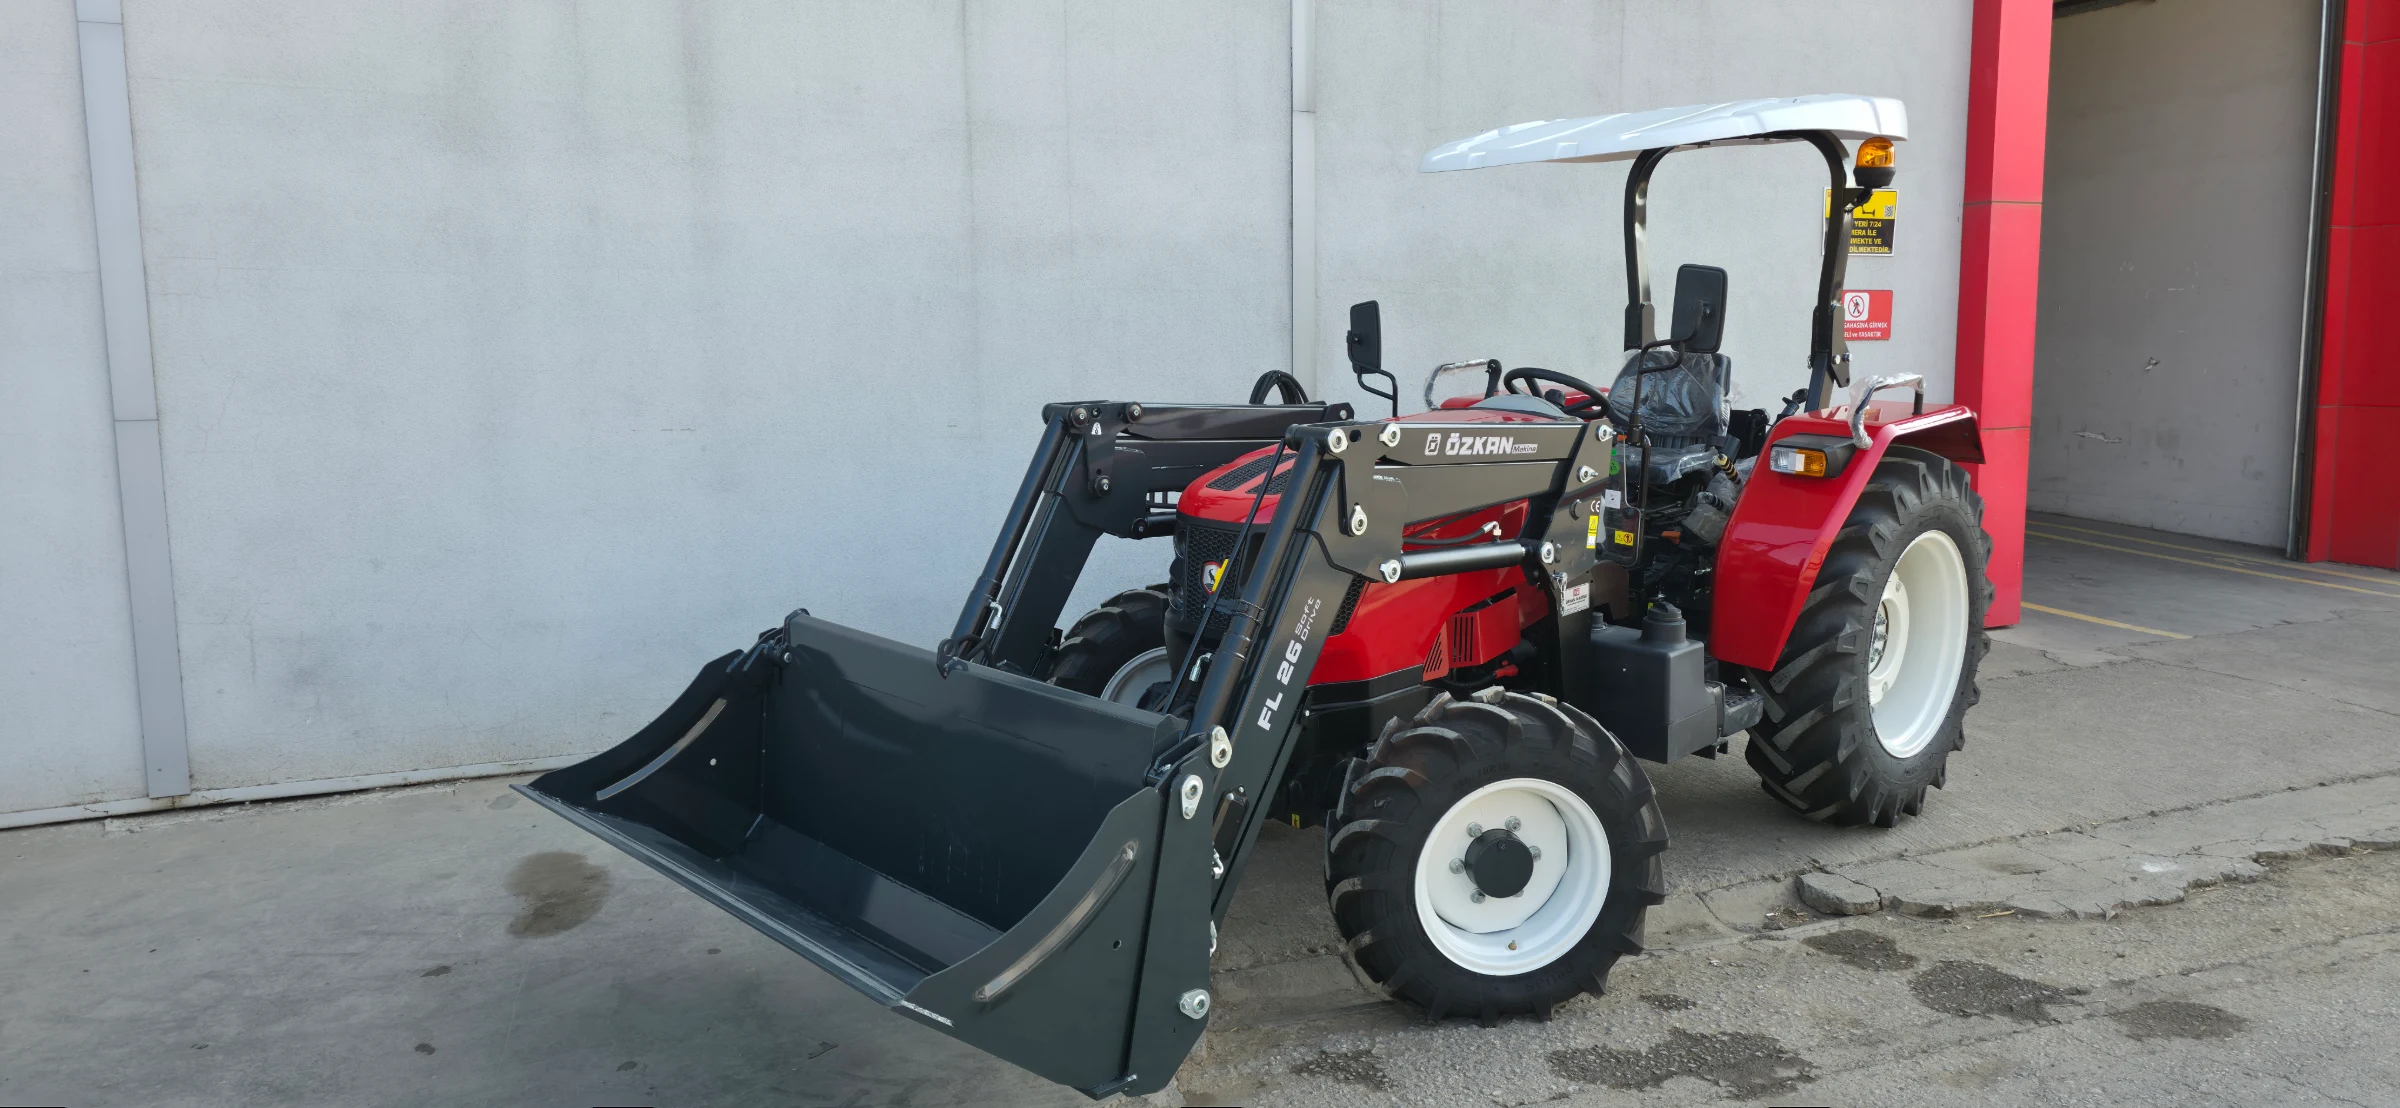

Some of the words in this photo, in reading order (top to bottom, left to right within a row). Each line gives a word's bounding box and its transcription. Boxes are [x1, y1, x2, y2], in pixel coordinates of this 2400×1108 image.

[1867, 228, 1877, 236] İLE
[1445, 432, 1514, 456] ÖZKAN
[1295, 596, 1315, 636] Soft
[1300, 598, 1322, 641] Drive
[1257, 692, 1283, 731] FL
[1276, 639, 1303, 686] 26
